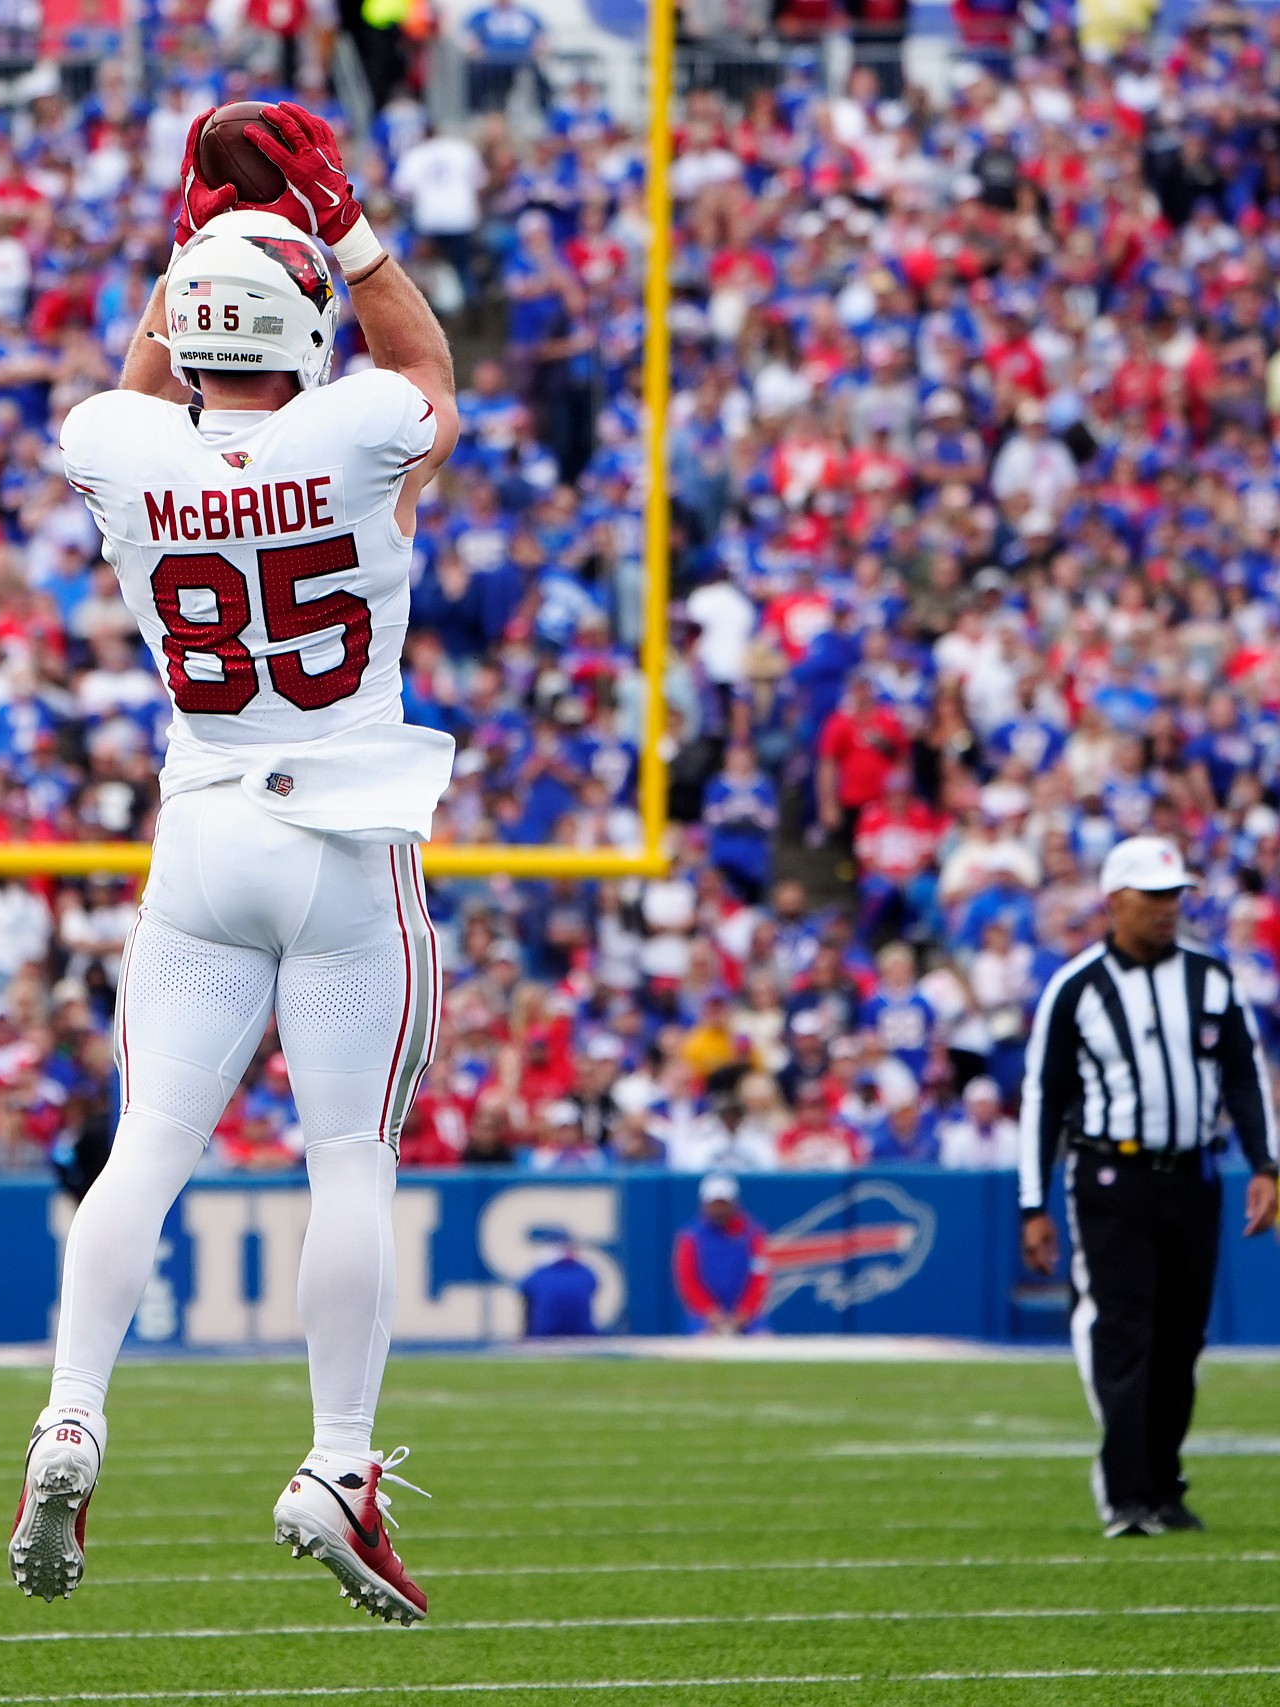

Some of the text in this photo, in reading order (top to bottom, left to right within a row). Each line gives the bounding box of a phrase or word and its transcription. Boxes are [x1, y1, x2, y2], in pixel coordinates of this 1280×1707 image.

[179, 351, 264, 363] INSPIRE CHANGE
[144, 476, 334, 541] McBRIDE
[151, 533, 372, 715] 85
[56, 1428, 82, 1445] 85
